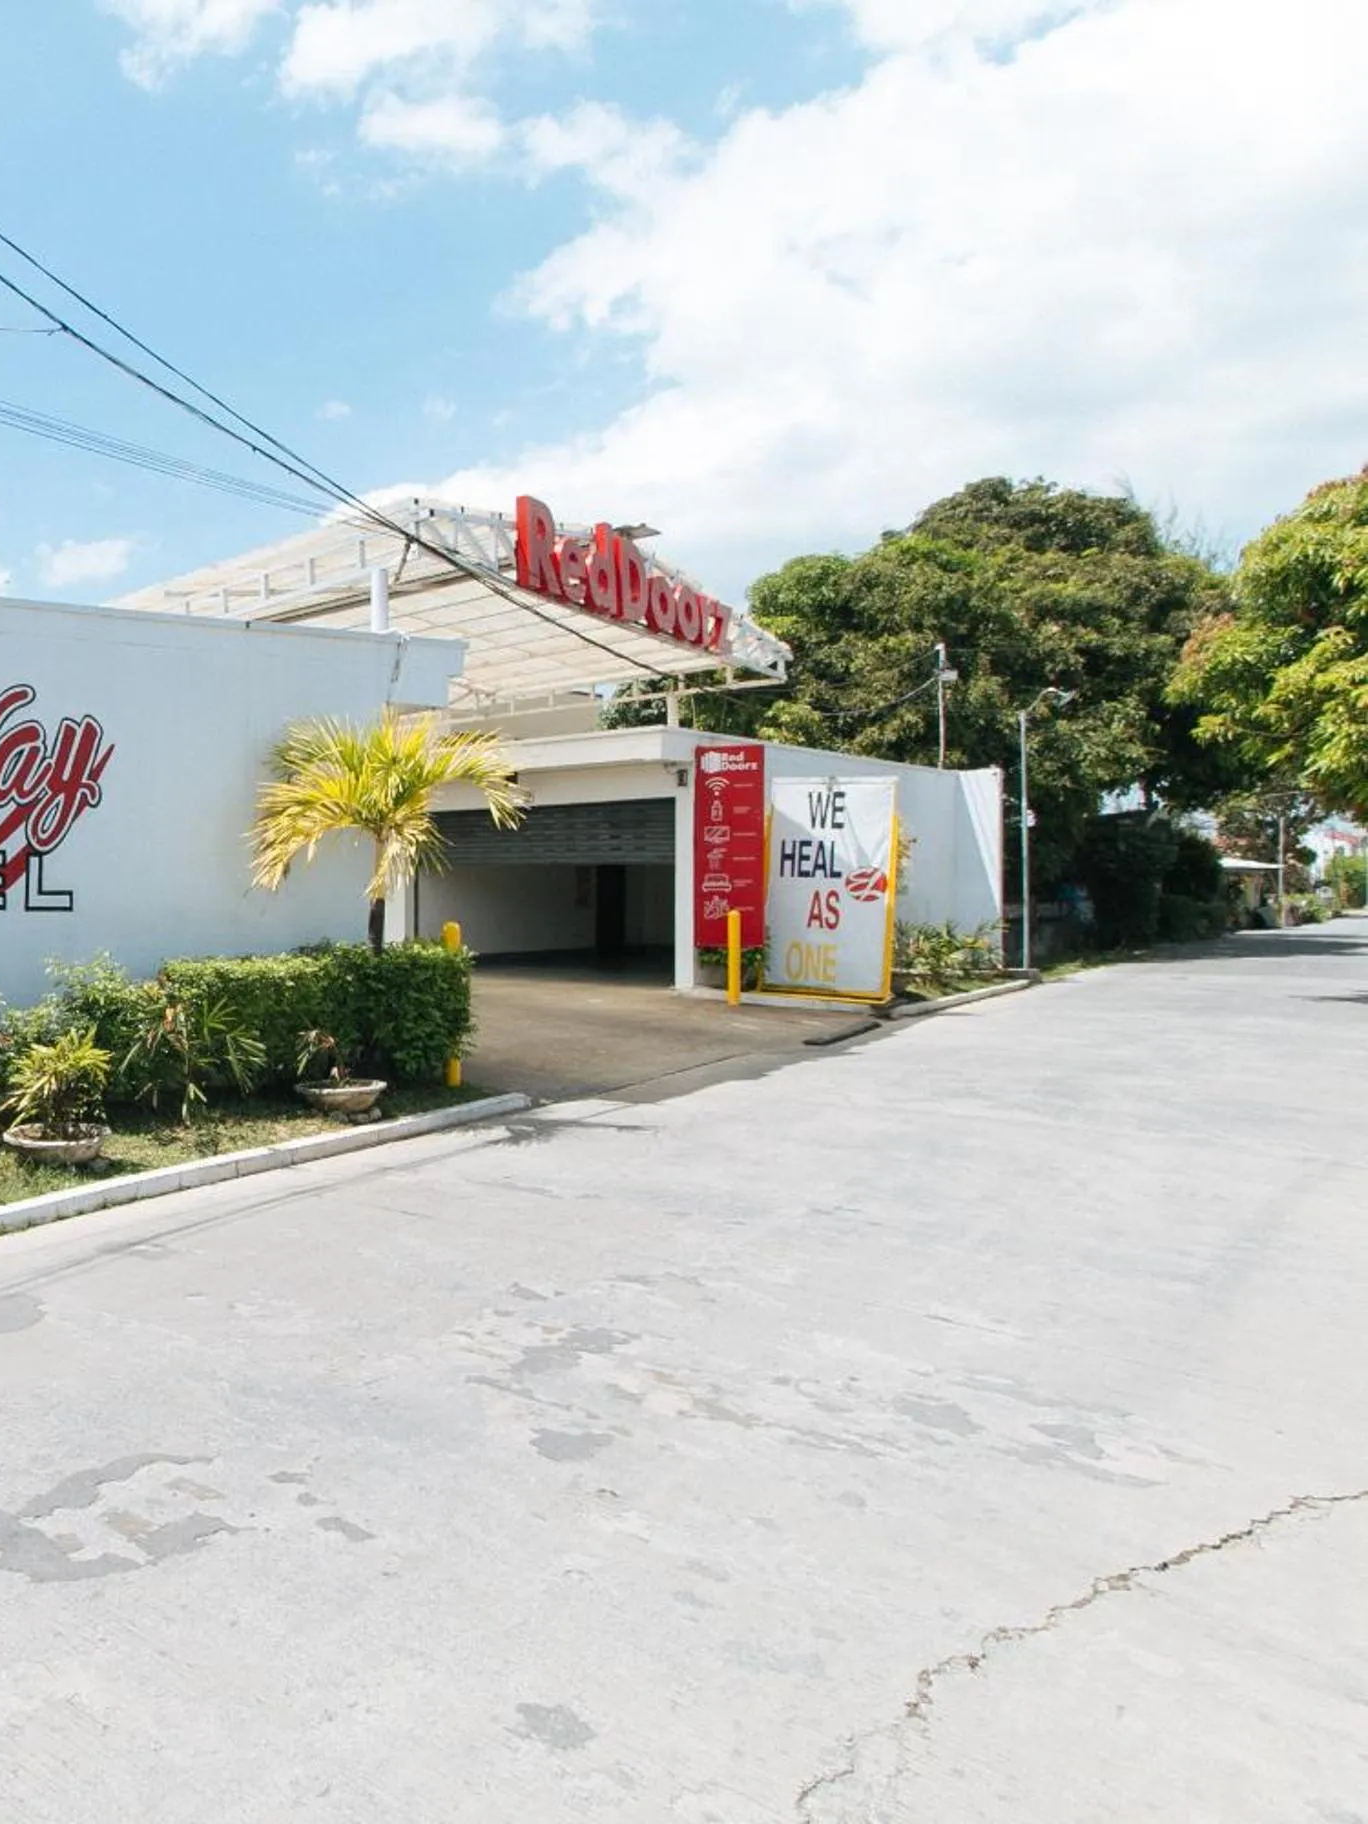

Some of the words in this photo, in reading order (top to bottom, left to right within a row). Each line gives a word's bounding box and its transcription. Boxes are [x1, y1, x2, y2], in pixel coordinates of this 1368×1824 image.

[808, 791, 845, 829] WE
[780, 840, 842, 878] HEAL
[807, 889, 840, 930] AS
[785, 940, 837, 983] ONE
